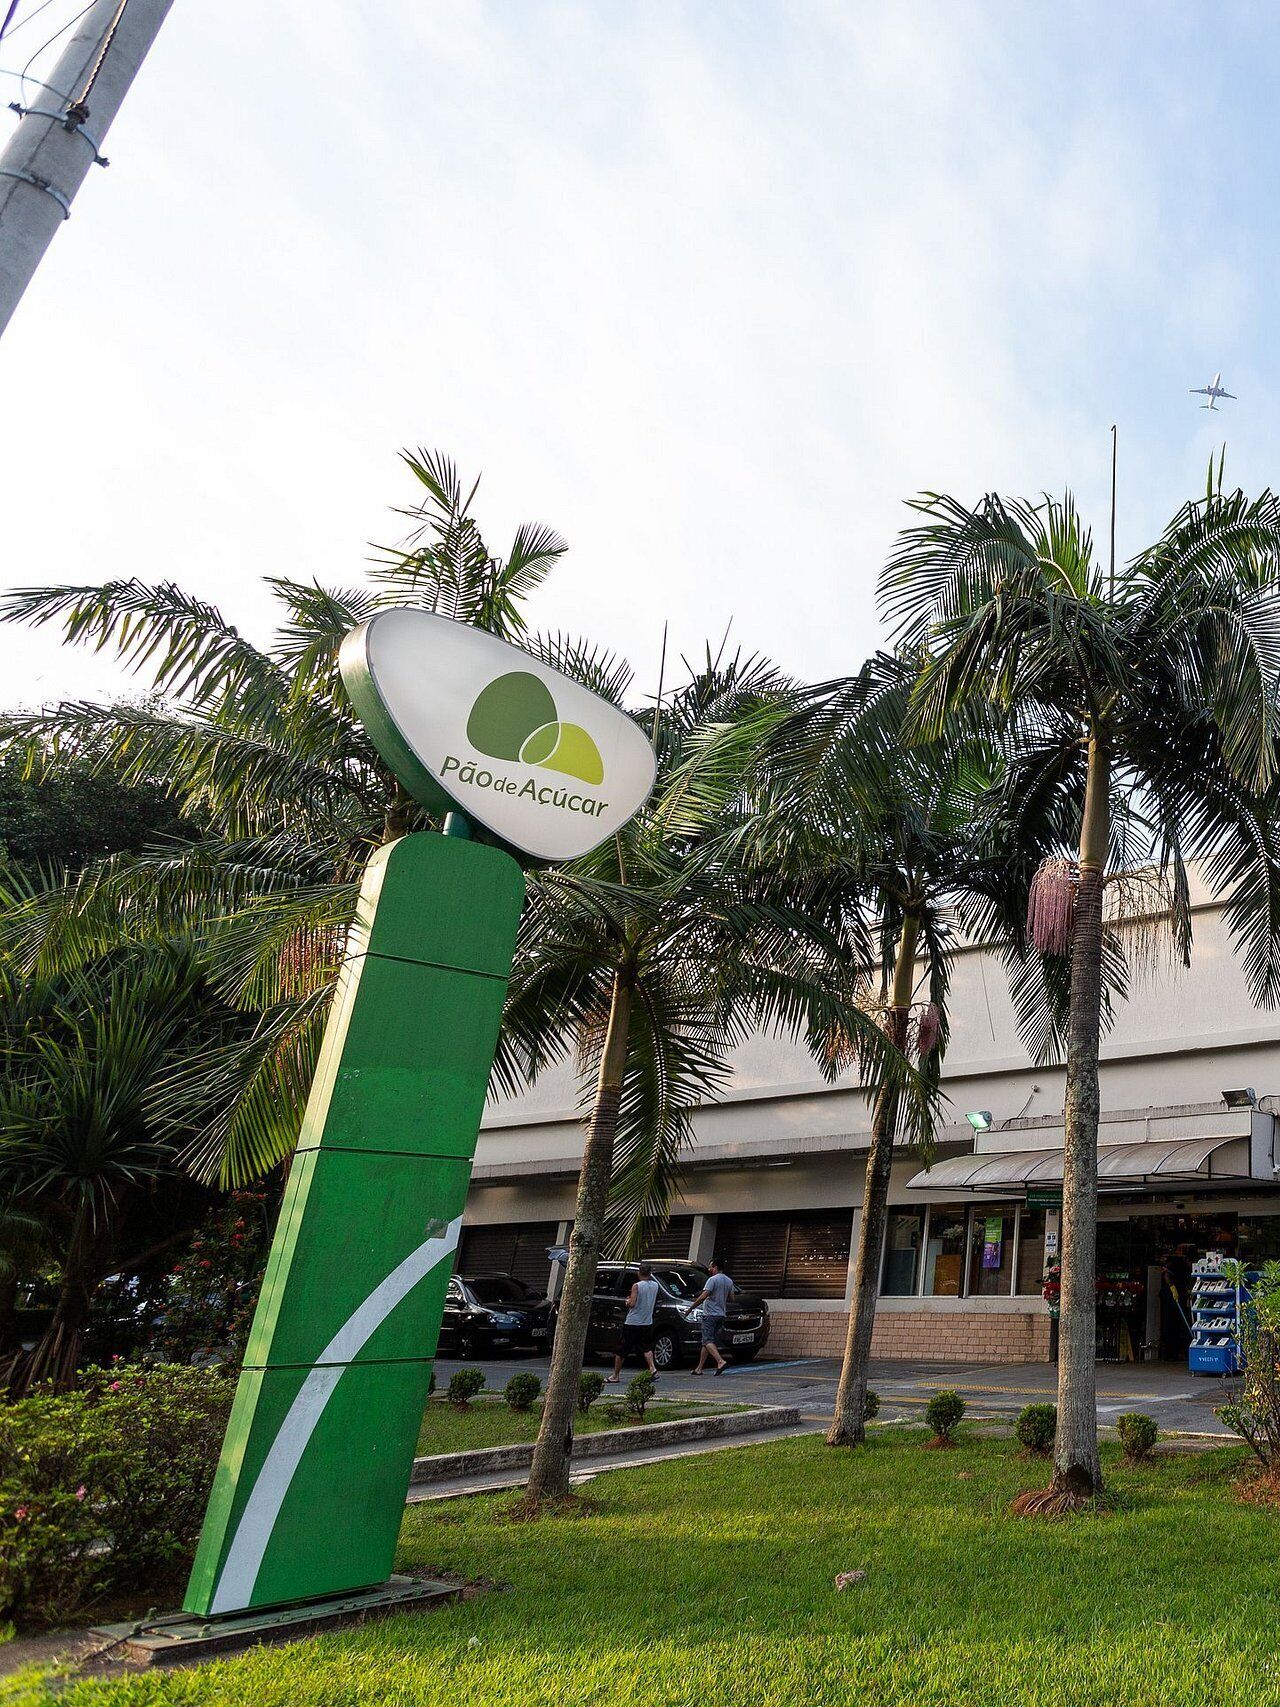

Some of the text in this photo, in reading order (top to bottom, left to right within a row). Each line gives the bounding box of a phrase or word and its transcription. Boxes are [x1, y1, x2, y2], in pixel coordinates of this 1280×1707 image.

[439, 755, 609, 817] Pão de Açúcar
